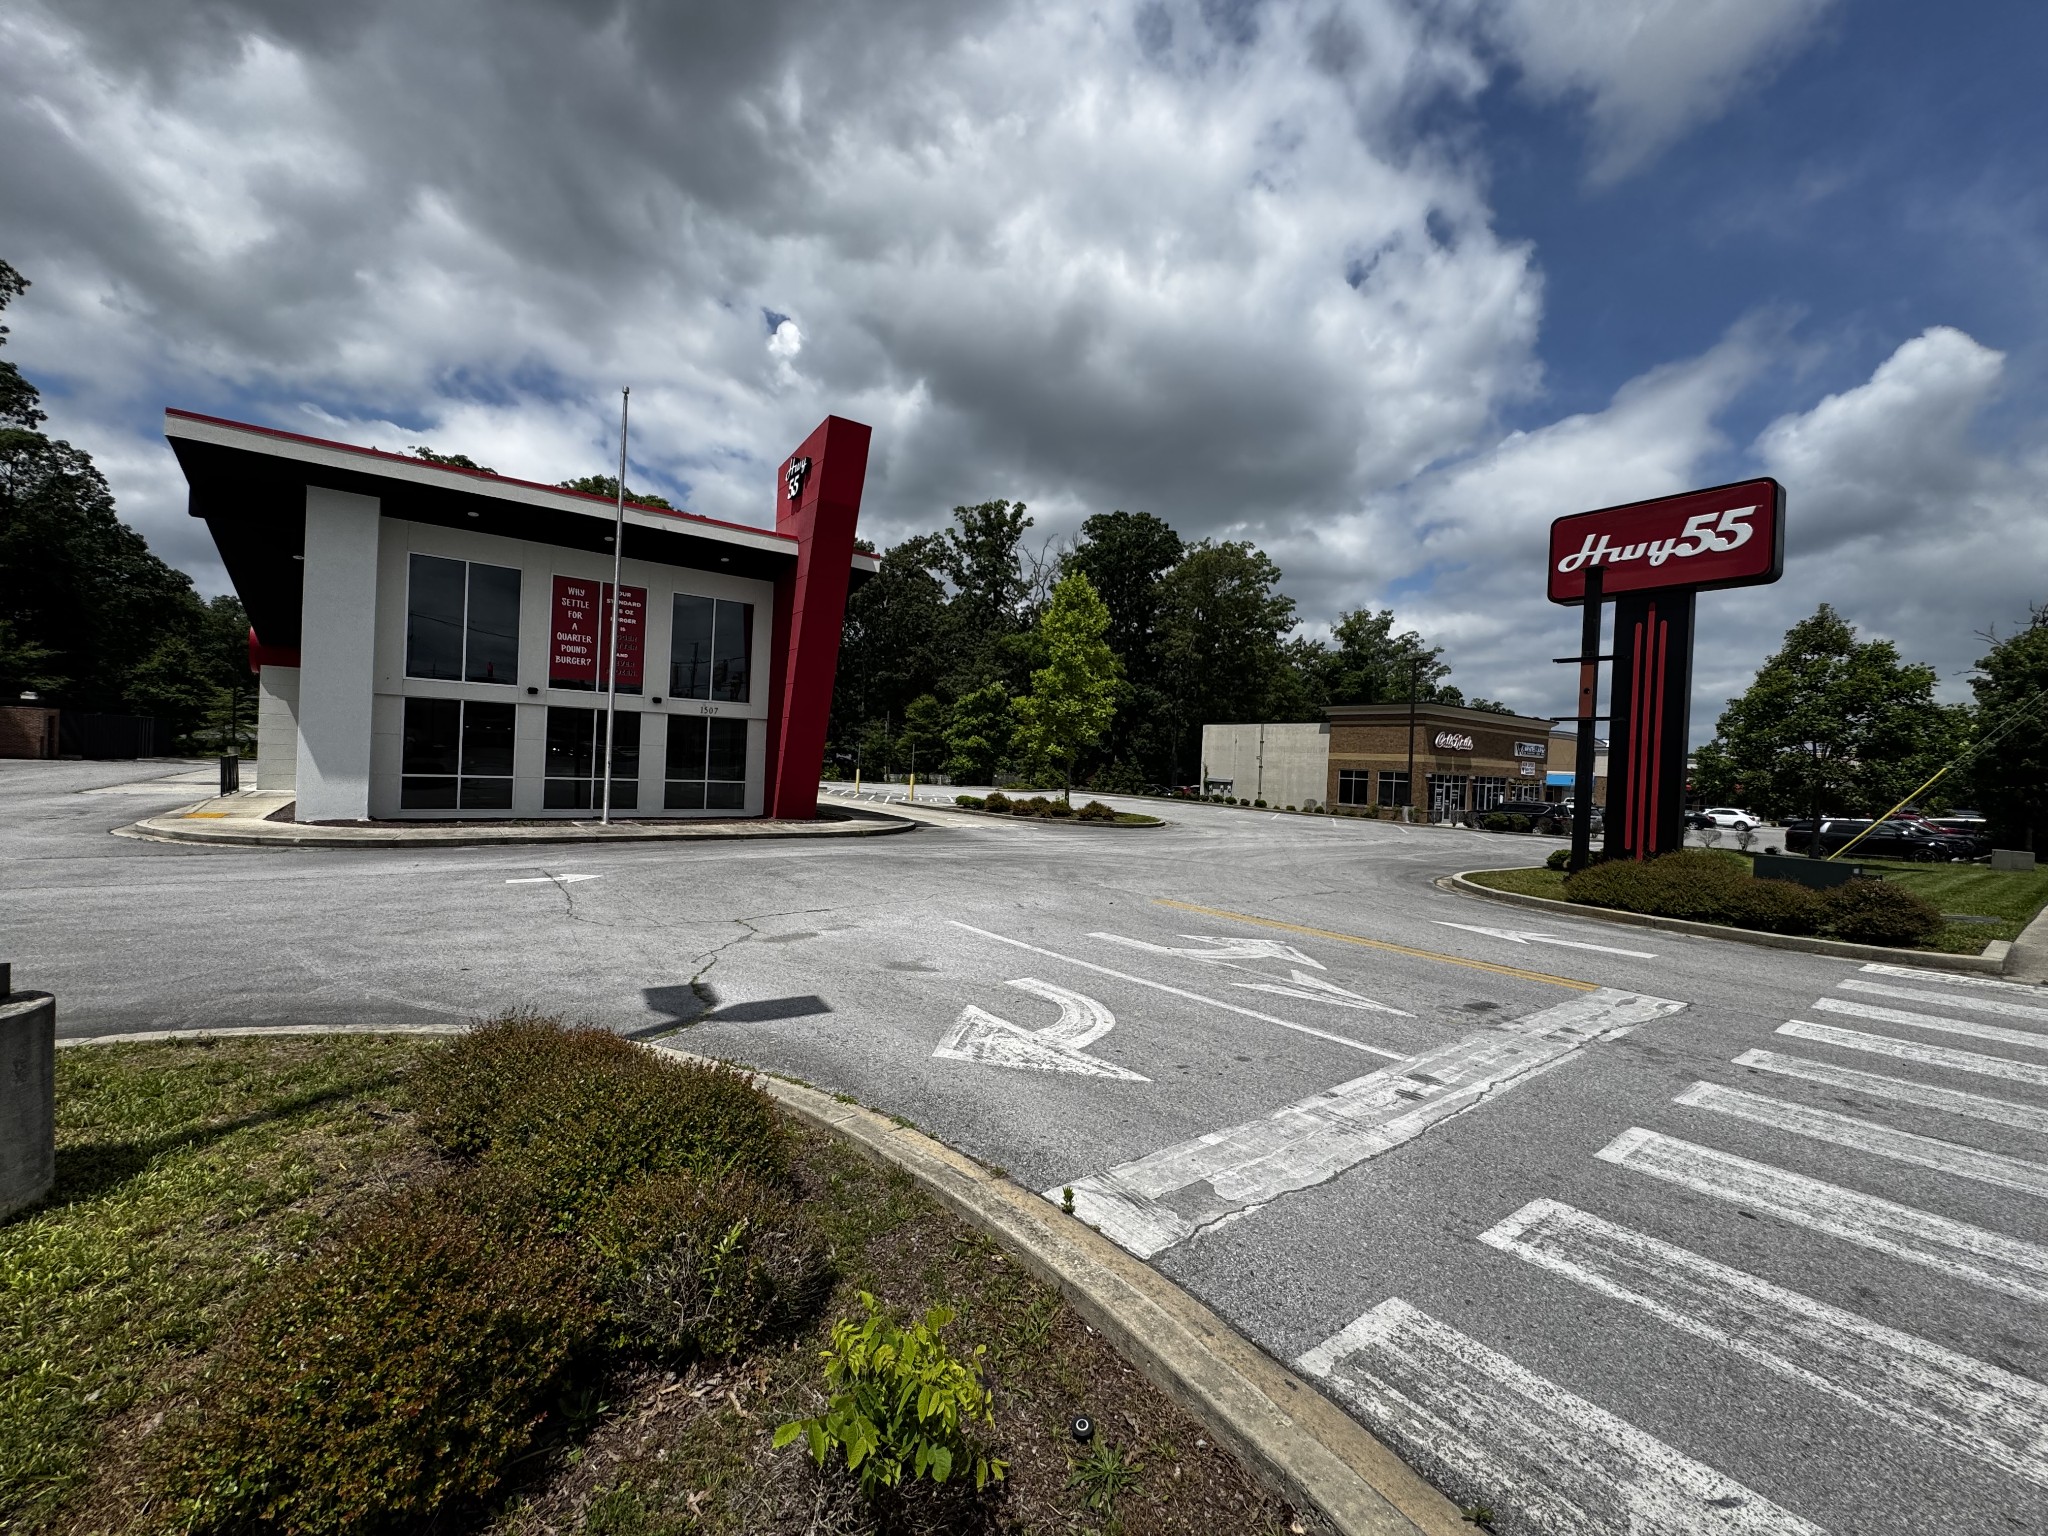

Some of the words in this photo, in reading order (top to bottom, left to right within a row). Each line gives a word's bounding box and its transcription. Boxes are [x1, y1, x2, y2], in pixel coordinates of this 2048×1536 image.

[787, 474, 800, 500] 55
[567, 586, 585, 596] WHY
[561, 597, 590, 609] SETTLE
[606, 598, 642, 608] STNDARD
[567, 610, 583, 620] FOR
[610, 616, 637, 624] RGER
[571, 622, 578, 631] A
[556, 631, 593, 644] QUARTER
[561, 644, 587, 654] POUND
[555, 655, 592, 666] BURGER?
[700, 706, 719, 714] 1507
